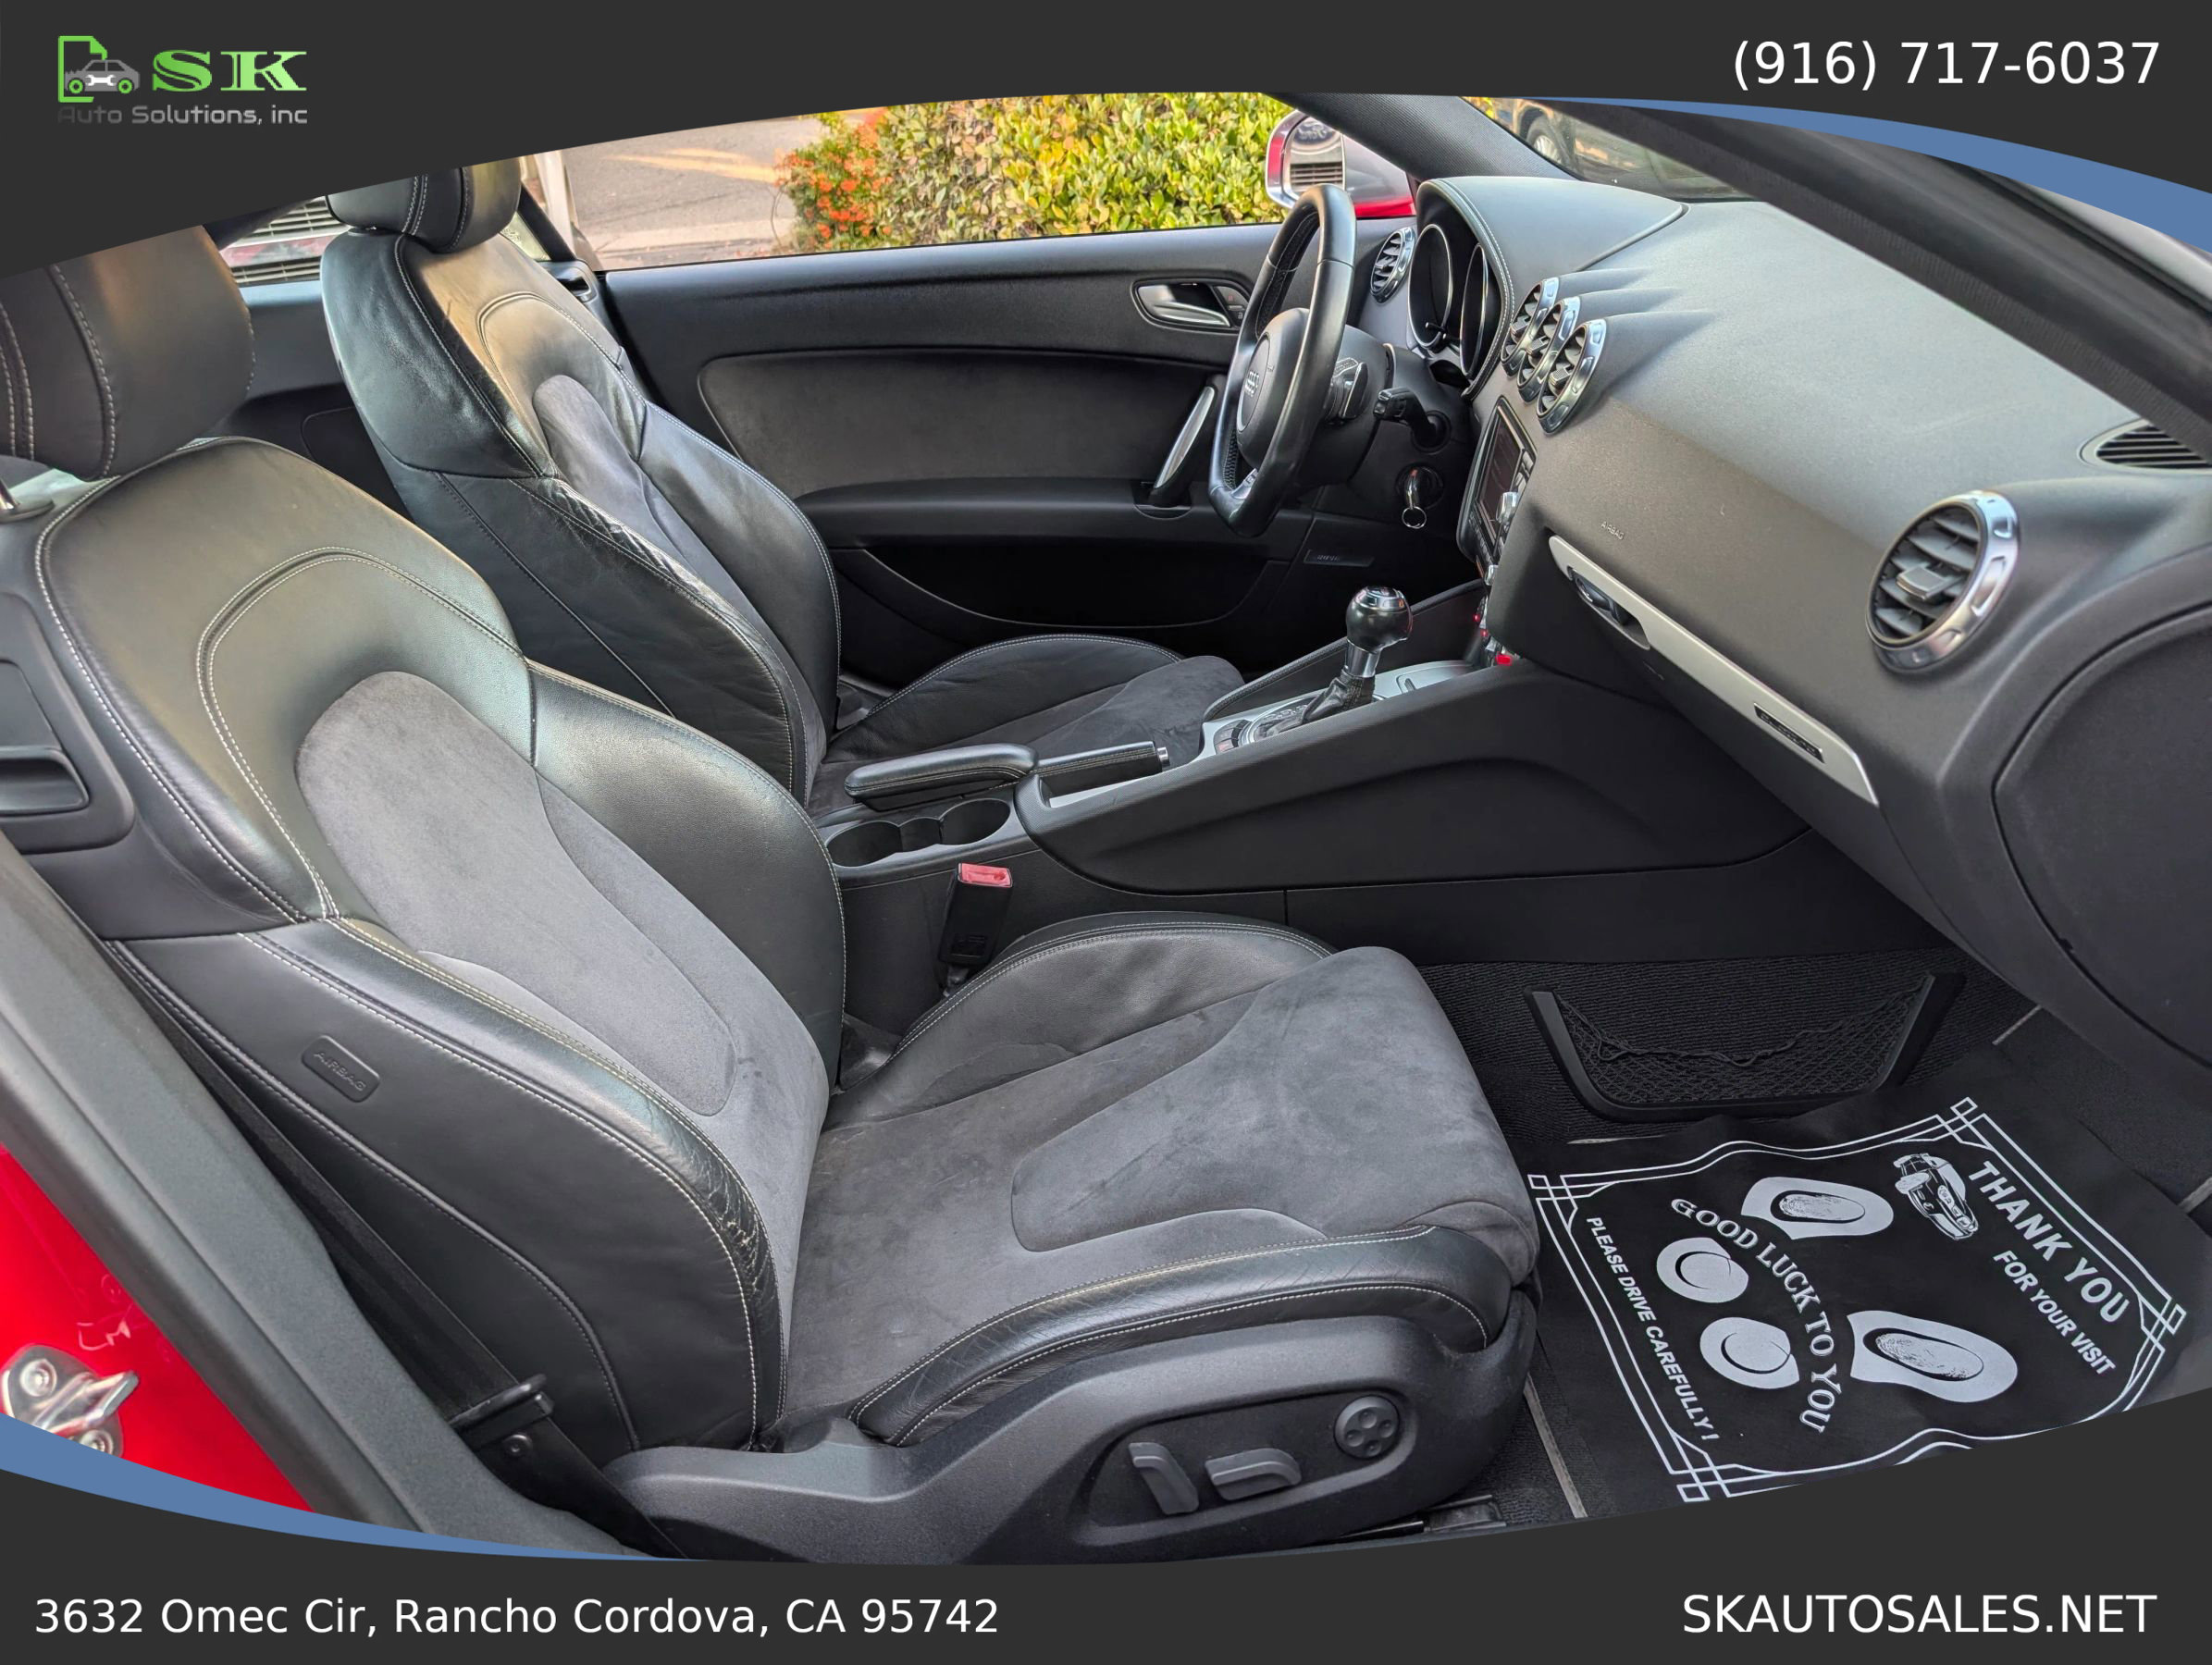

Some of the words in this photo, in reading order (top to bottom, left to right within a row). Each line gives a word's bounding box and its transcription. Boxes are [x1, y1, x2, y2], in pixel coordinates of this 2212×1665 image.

[314, 1052, 366, 1092] AIRBAG
[1671, 1198, 1759, 1250] GOOD
[1969, 1160, 2073, 1262] THANK
[2063, 1257, 2130, 1323] YOU
[1587, 1216, 1629, 1277] PLEASE
[1617, 1276, 1657, 1322] DRIVE
[1755, 1241, 1822, 1314] LUCK
[1805, 1311, 1835, 1357] TO
[1993, 1250, 2039, 1292] FOR
[2030, 1289, 2078, 1338] YOUR
[2070, 1331, 2117, 1375] VISIT
[1798, 1363, 1843, 1434] YOU
